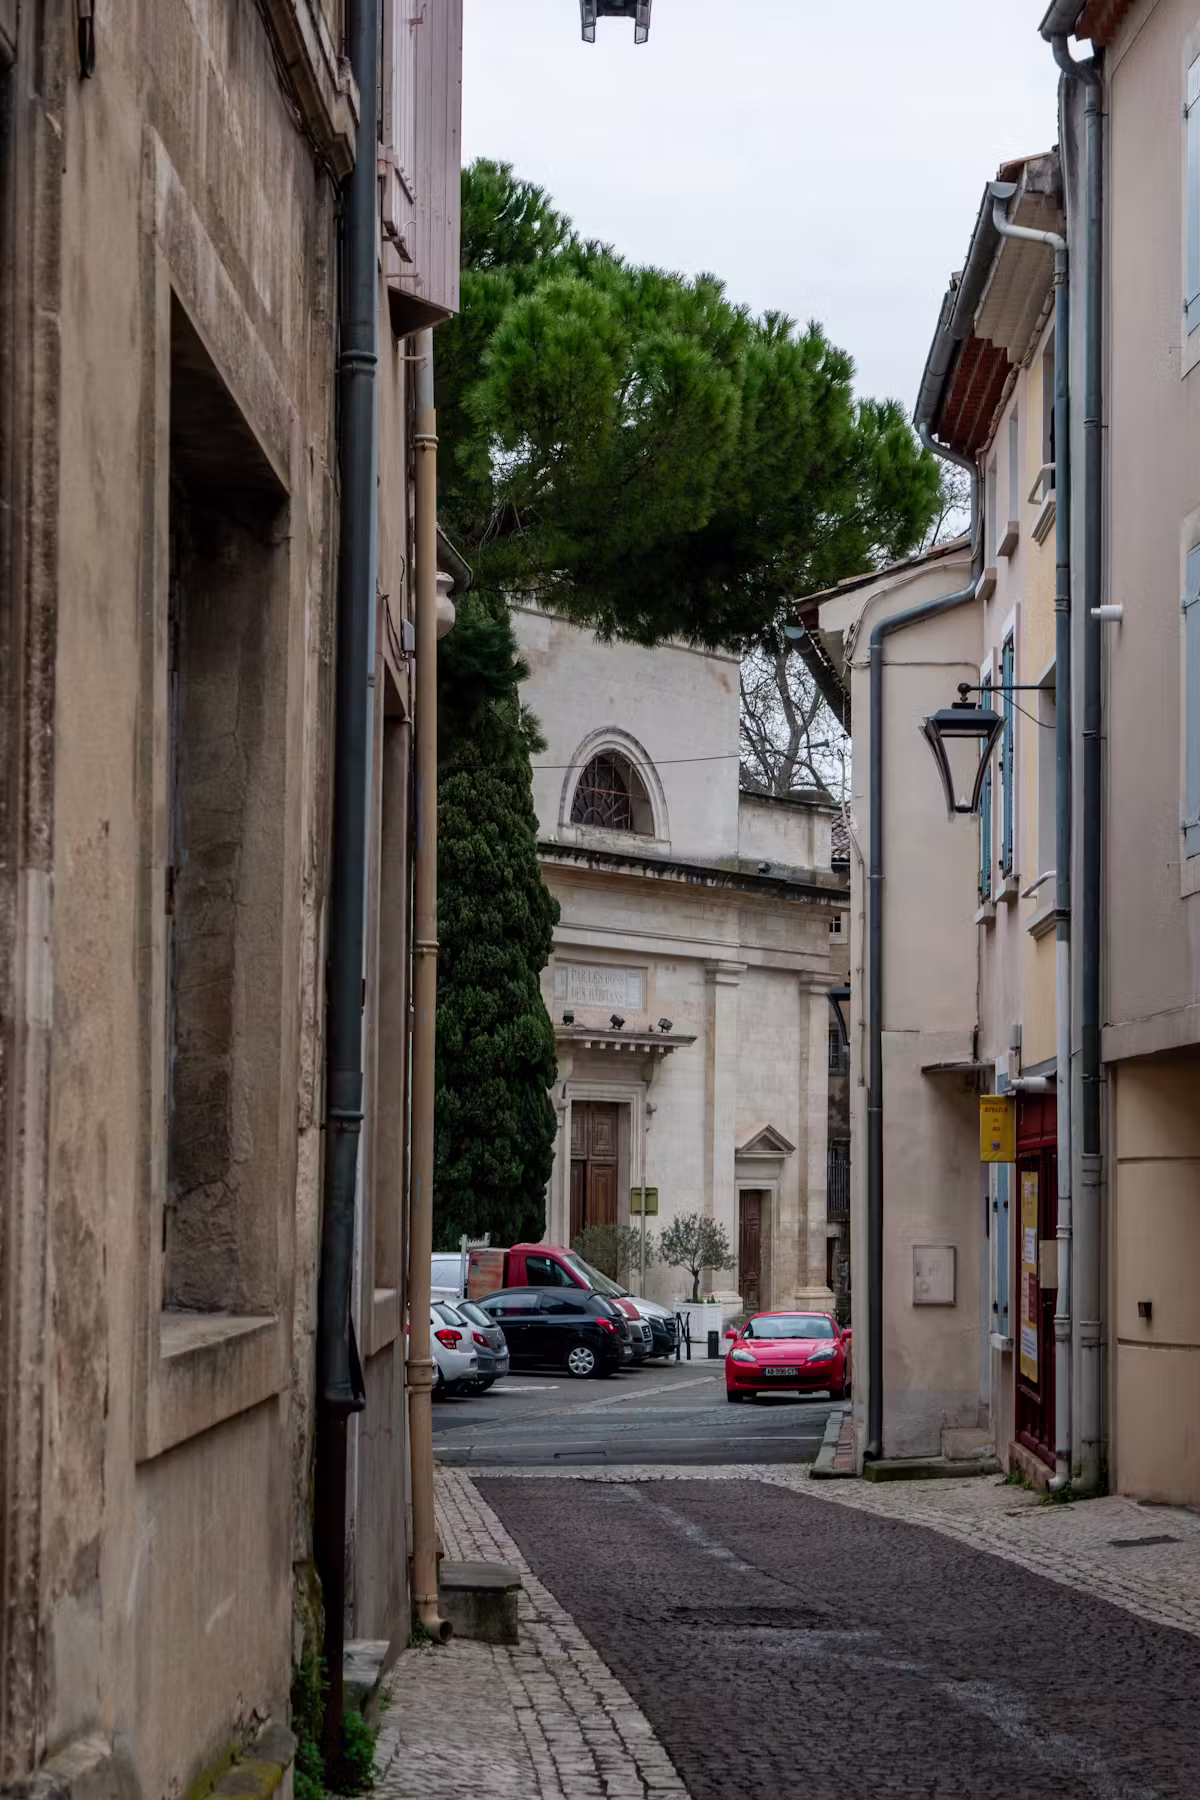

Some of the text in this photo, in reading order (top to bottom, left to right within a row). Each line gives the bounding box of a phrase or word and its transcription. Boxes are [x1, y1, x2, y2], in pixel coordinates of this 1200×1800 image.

[571, 968, 586, 983] PAR
[588, 970, 604, 985] LES
[571, 985, 586, 1000] DES
